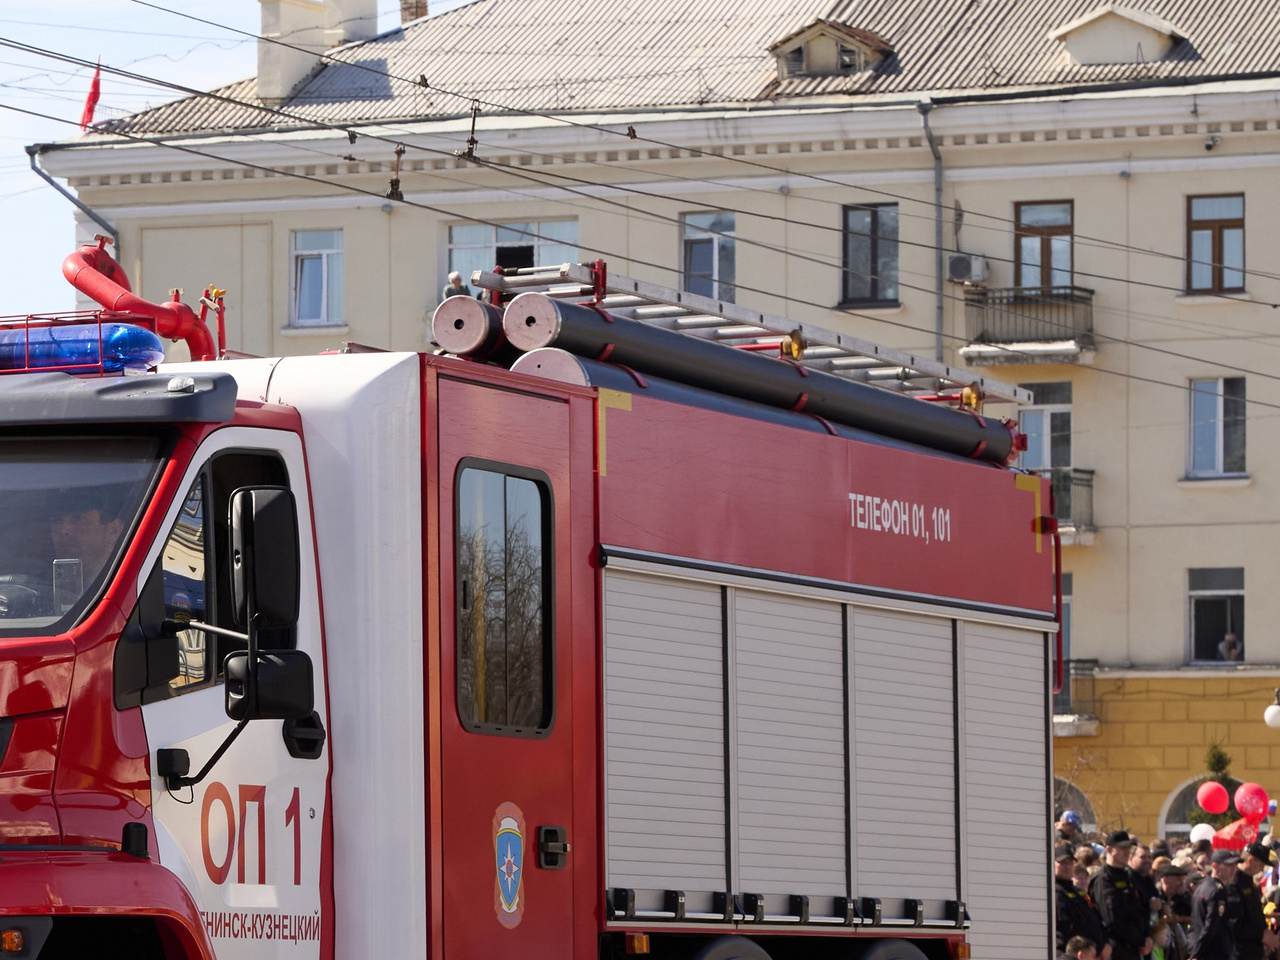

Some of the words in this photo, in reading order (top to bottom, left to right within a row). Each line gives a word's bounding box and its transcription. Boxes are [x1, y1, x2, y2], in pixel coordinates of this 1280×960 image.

[848, 492, 910, 536] ТЕЛЕФОН
[912, 503, 929, 545] 01,
[931, 506, 951, 542] 101
[200, 781, 267, 885] ОП
[285, 786, 302, 886] 1
